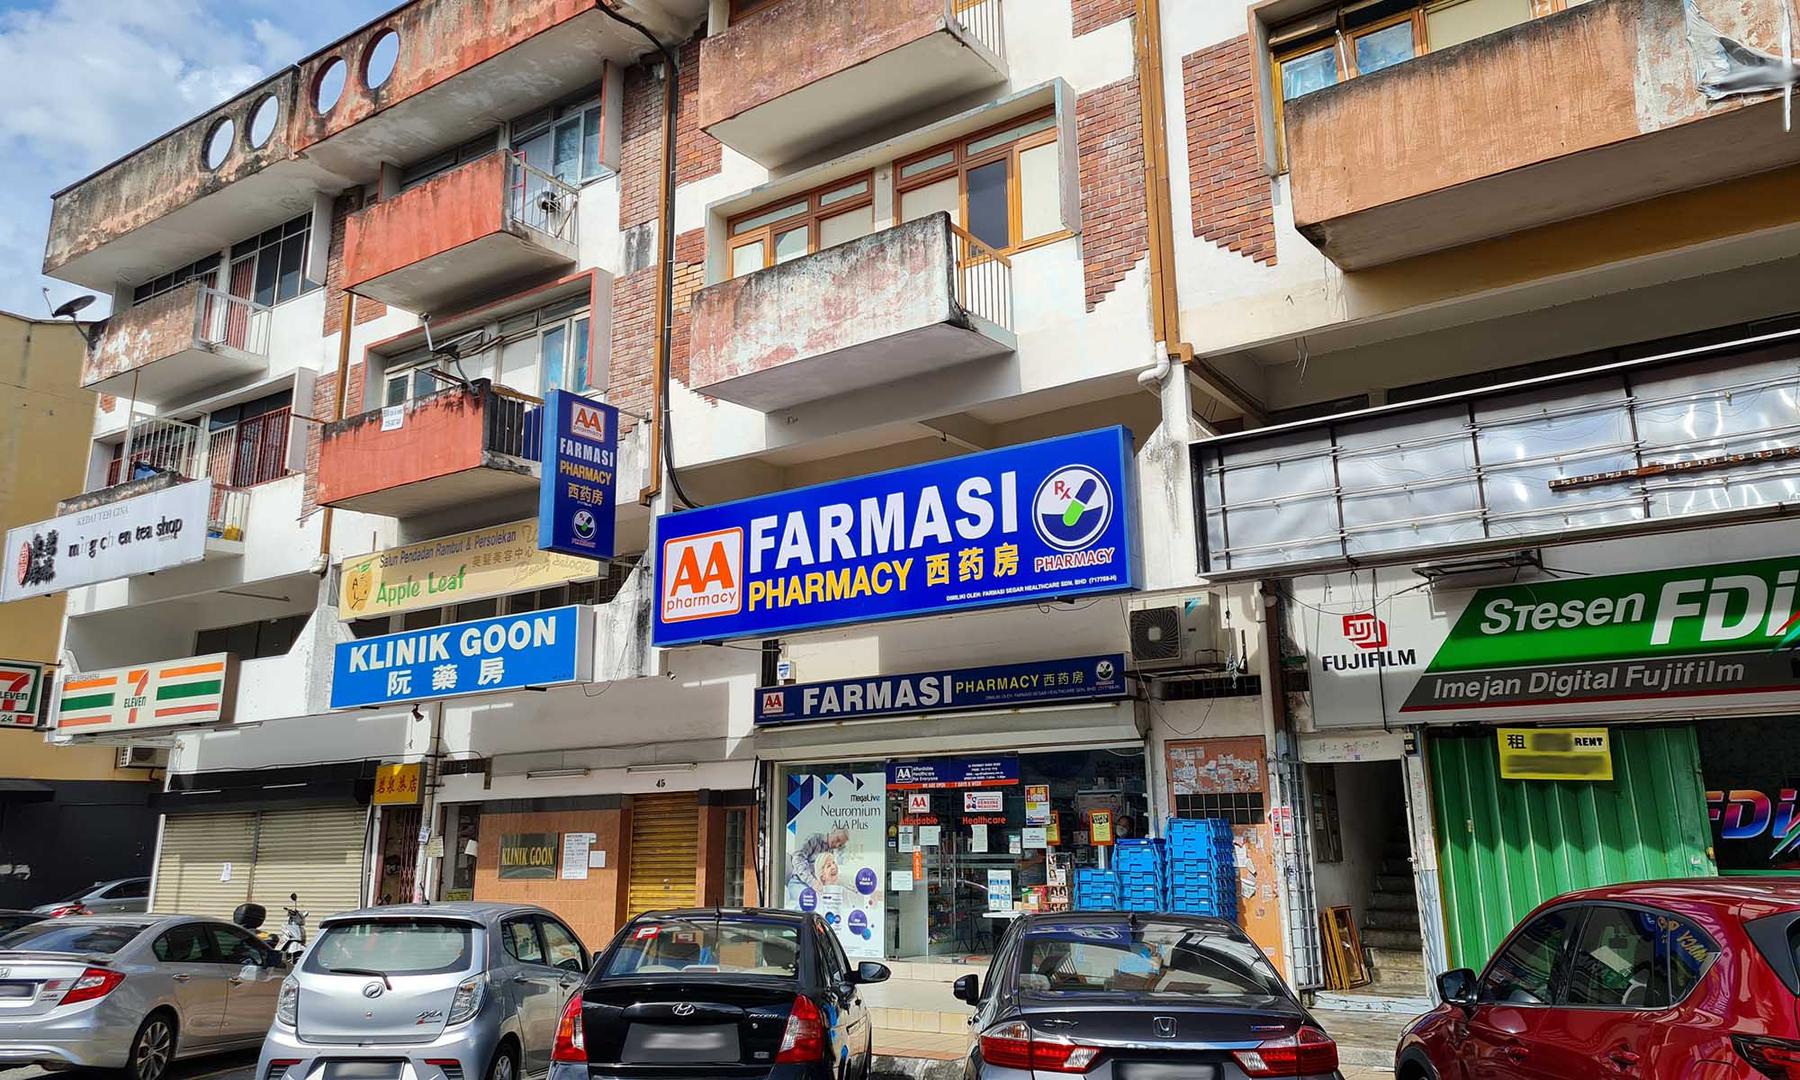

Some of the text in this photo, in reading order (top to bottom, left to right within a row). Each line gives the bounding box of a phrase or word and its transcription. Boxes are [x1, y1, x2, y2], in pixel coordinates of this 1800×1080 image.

[575, 407, 602, 433] AA
[560, 437, 614, 467] FARMASI
[560, 460, 612, 486] PHARMACY
[568, 482, 604, 506] 西药房
[136, 525, 154, 541] tea
[156, 516, 183, 539] shop
[750, 470, 1018, 574] FARMASI
[465, 539, 471, 550] &
[670, 541, 734, 597] AA
[926, 542, 1019, 587] 西药房
[1034, 547, 1115, 573] PHARMACY
[376, 564, 466, 607] Apple Leaf
[749, 558, 914, 612] PHARMACY
[982, 588, 1005, 598] FARMASI
[1006, 586, 1024, 594] SEGAR
[1024, 582, 1060, 592] HEALTHCARE
[1074, 578, 1086, 586] BHD
[666, 591, 737, 613] pharmacy
[349, 616, 556, 673] KLINIK GOON
[1322, 649, 1416, 672] FUJIFILM
[386, 656, 505, 698] 阮藥房
[1434, 660, 1744, 702] Imejan Digital Fujifilm
[764, 694, 782, 708] AA
[802, 670, 1084, 715] FARMASI PHARMACY 西药房
[1, 714, 13, 722] 24
[1506, 734, 1526, 750] 租
[1574, 737, 1604, 746] RENT
[656, 778, 666, 788] 45
[897, 768, 911, 778] AA
[820, 805, 880, 816] Neuromium
[912, 797, 926, 807] AA
[832, 819, 869, 830] ALA Plus
[962, 816, 1006, 824] Healthcare
[502, 847, 528, 866] KLINIK
[530, 846, 554, 866] GOON
